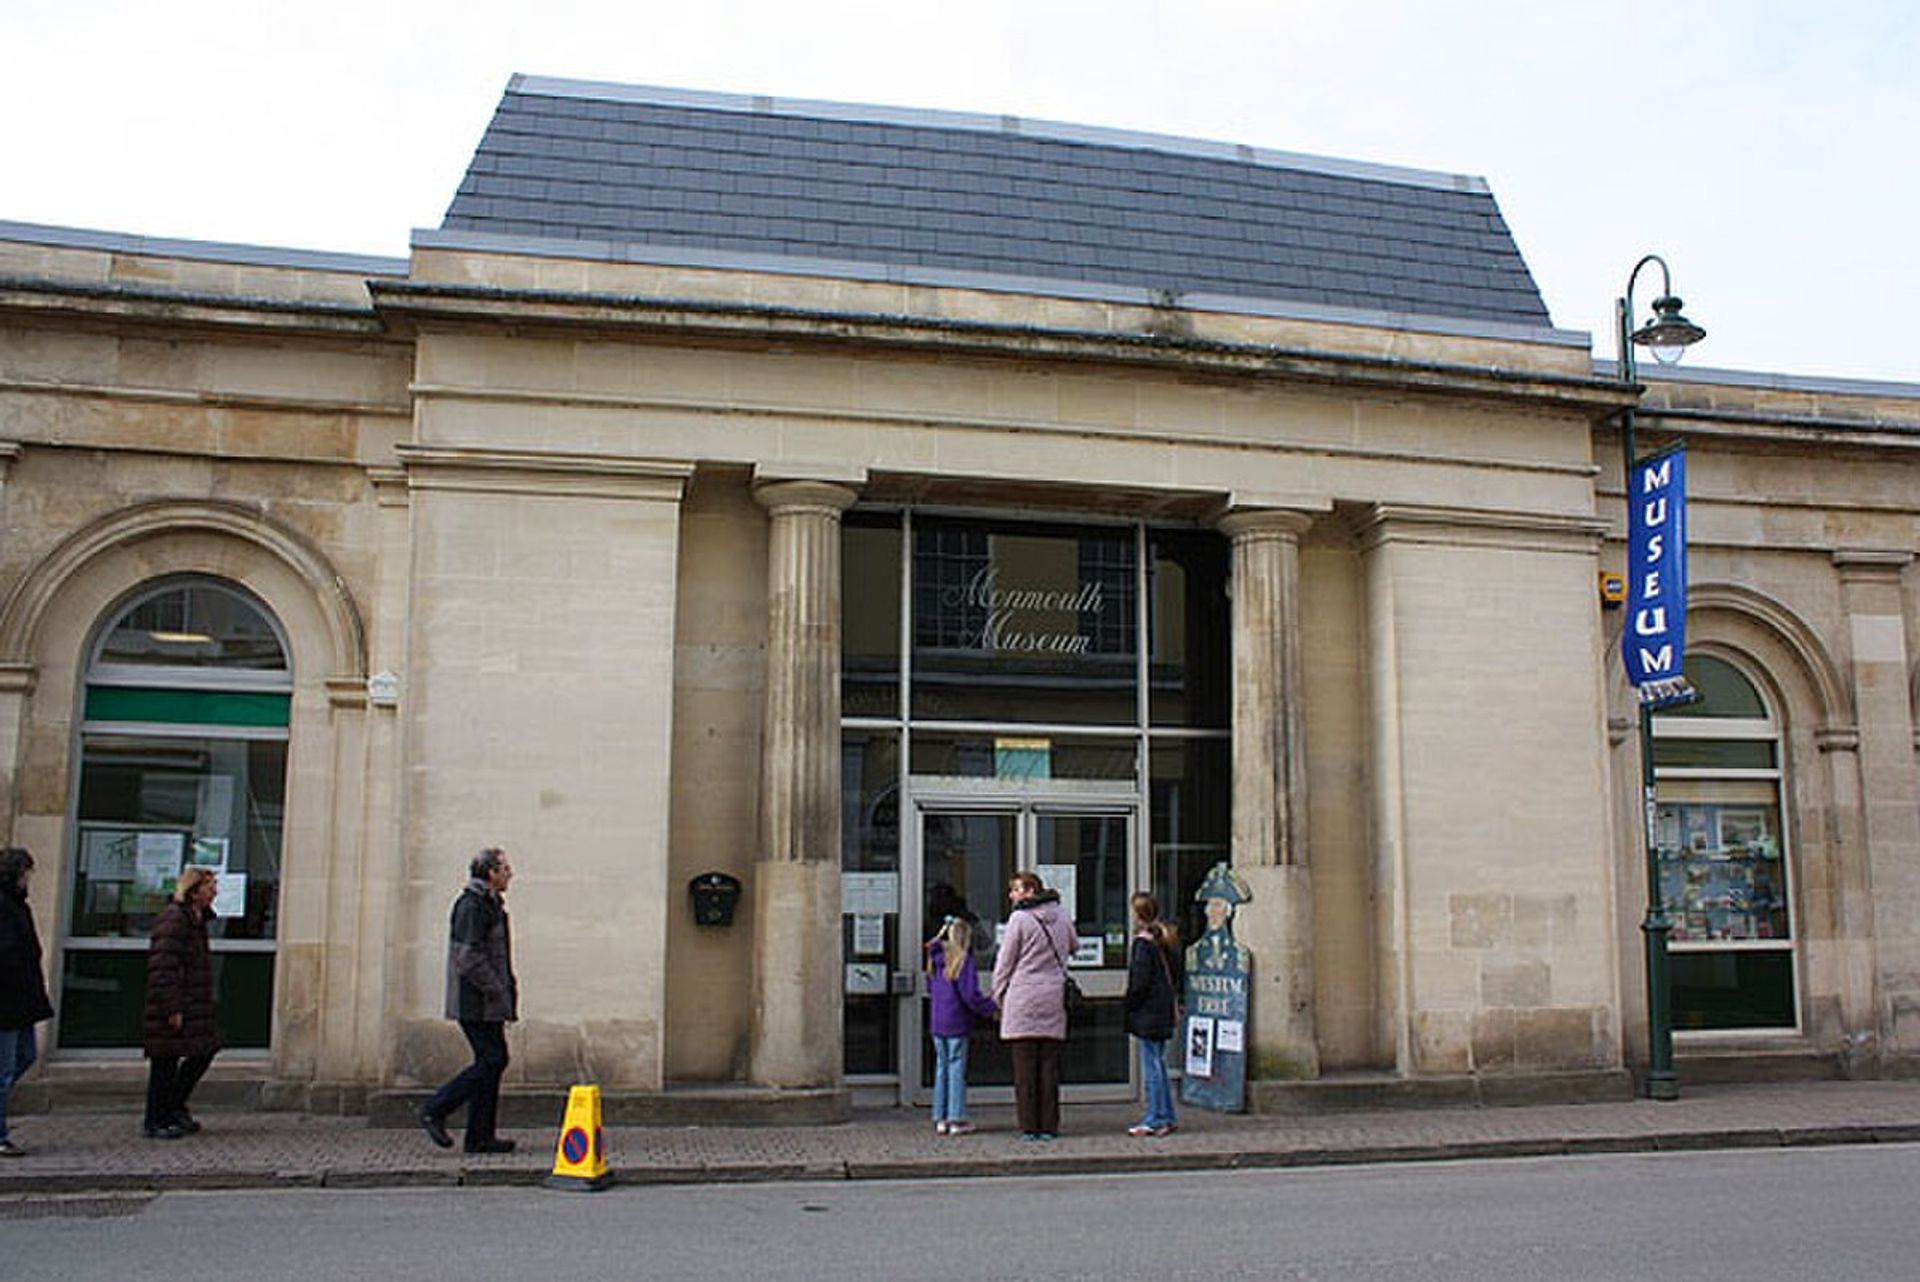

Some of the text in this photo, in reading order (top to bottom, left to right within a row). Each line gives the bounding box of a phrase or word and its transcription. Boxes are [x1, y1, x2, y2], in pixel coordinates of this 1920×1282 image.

[1635, 460, 1672, 673] MUSEUM
[944, 567, 1105, 614] Monmouth
[963, 609, 1091, 655] Museum
